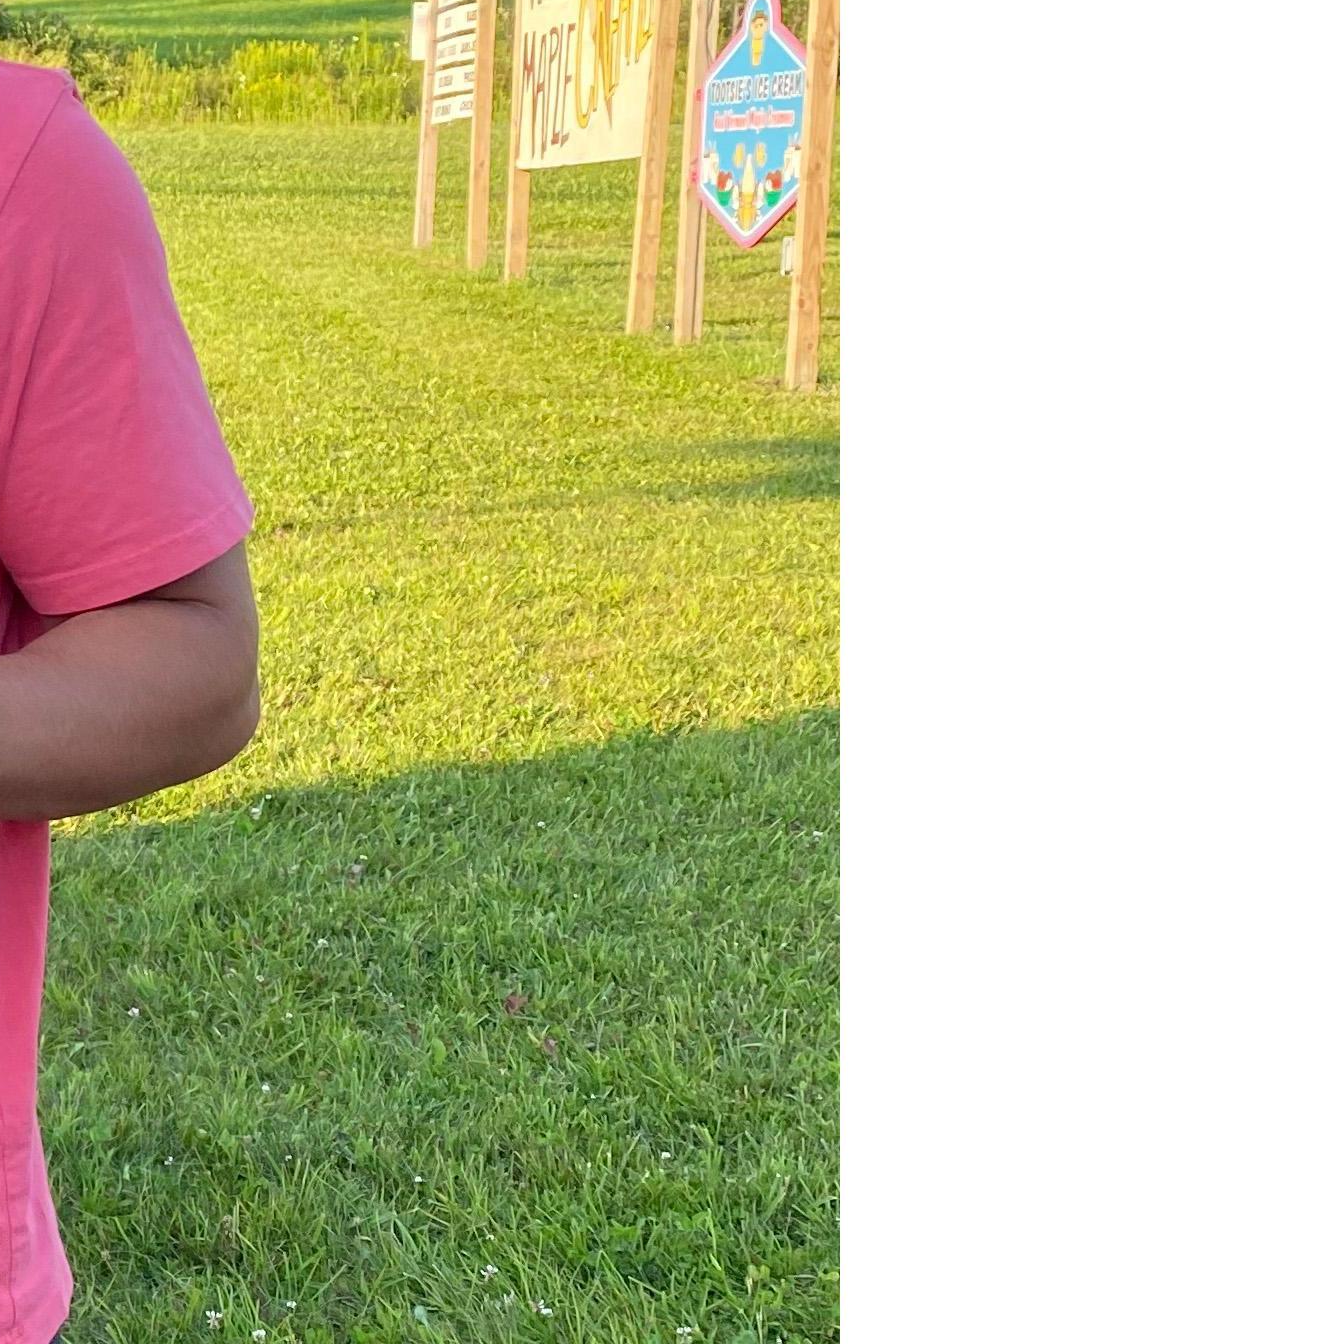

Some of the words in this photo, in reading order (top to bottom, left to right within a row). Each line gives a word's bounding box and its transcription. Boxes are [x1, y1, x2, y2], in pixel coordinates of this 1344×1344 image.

[517, 22, 576, 160] MAPLE
[711, 75, 753, 105] TOOTSIE'S
[753, 74, 770, 100] ICE
[771, 70, 803, 99] CREAM
